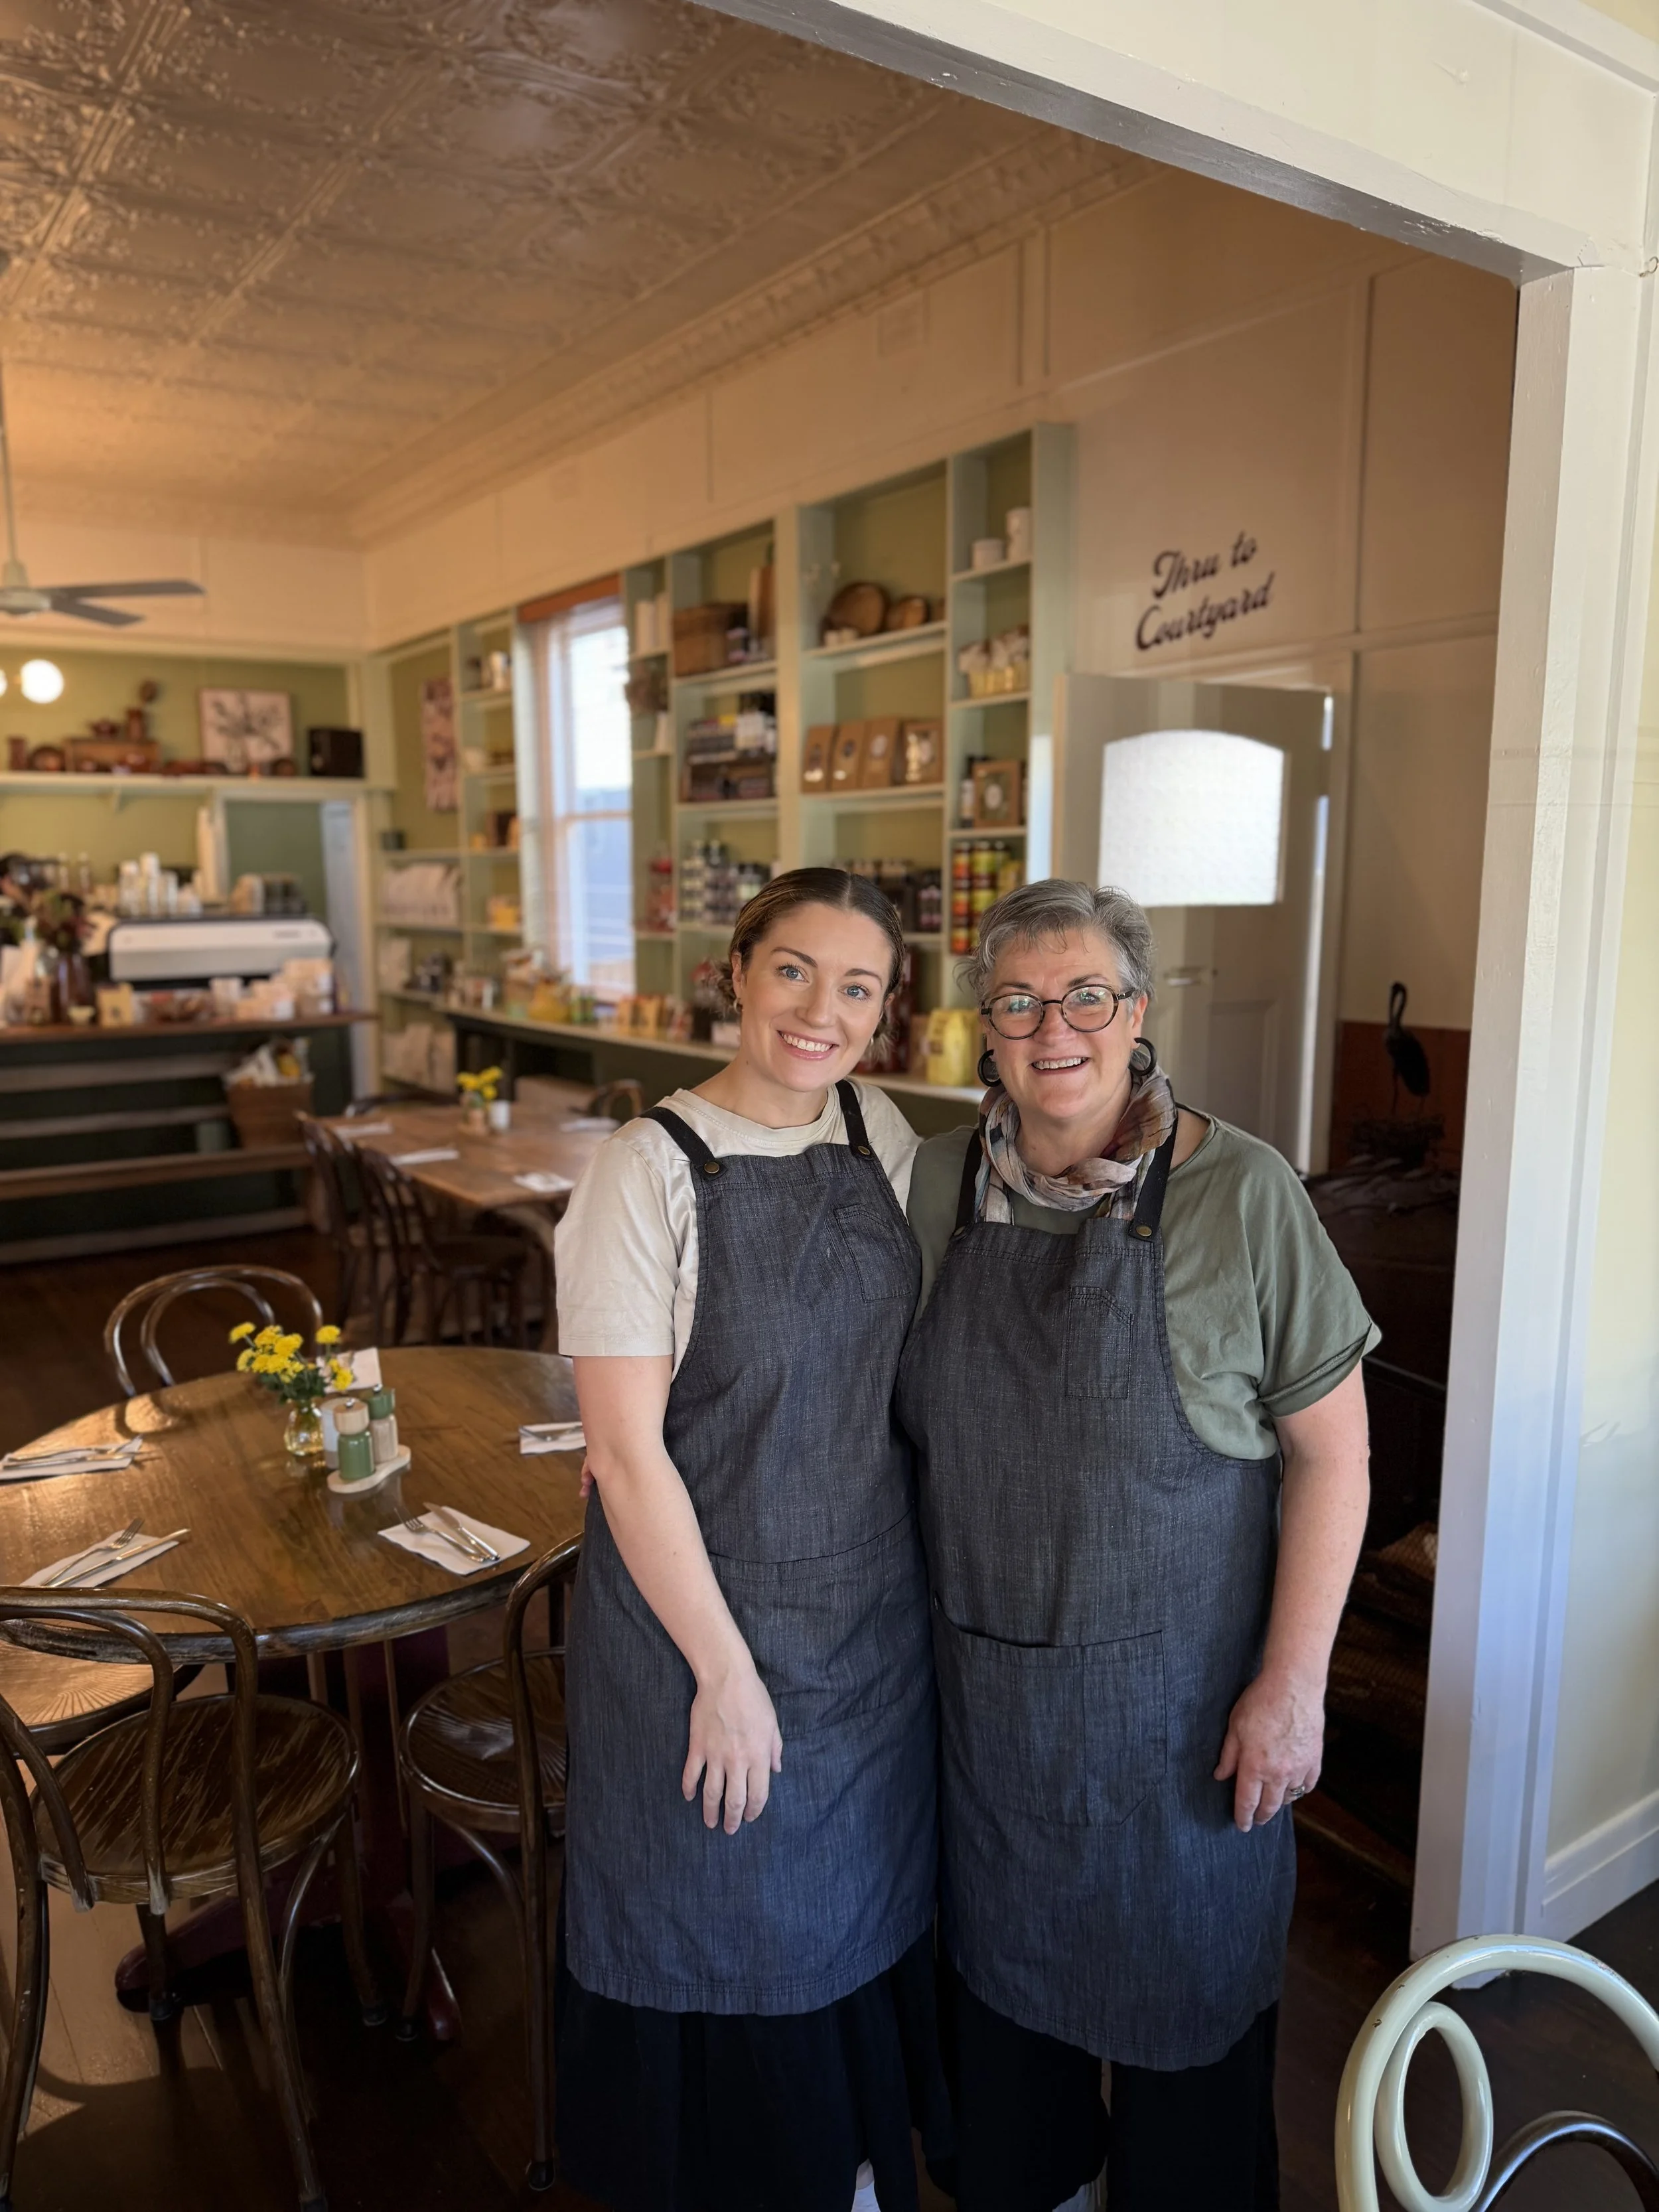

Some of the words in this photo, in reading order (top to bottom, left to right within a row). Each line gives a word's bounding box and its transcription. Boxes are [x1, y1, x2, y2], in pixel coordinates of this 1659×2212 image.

[1152, 550, 1220, 599] Thru
[1230, 530, 1258, 567] to
[1135, 571, 1275, 651] Courtyard
